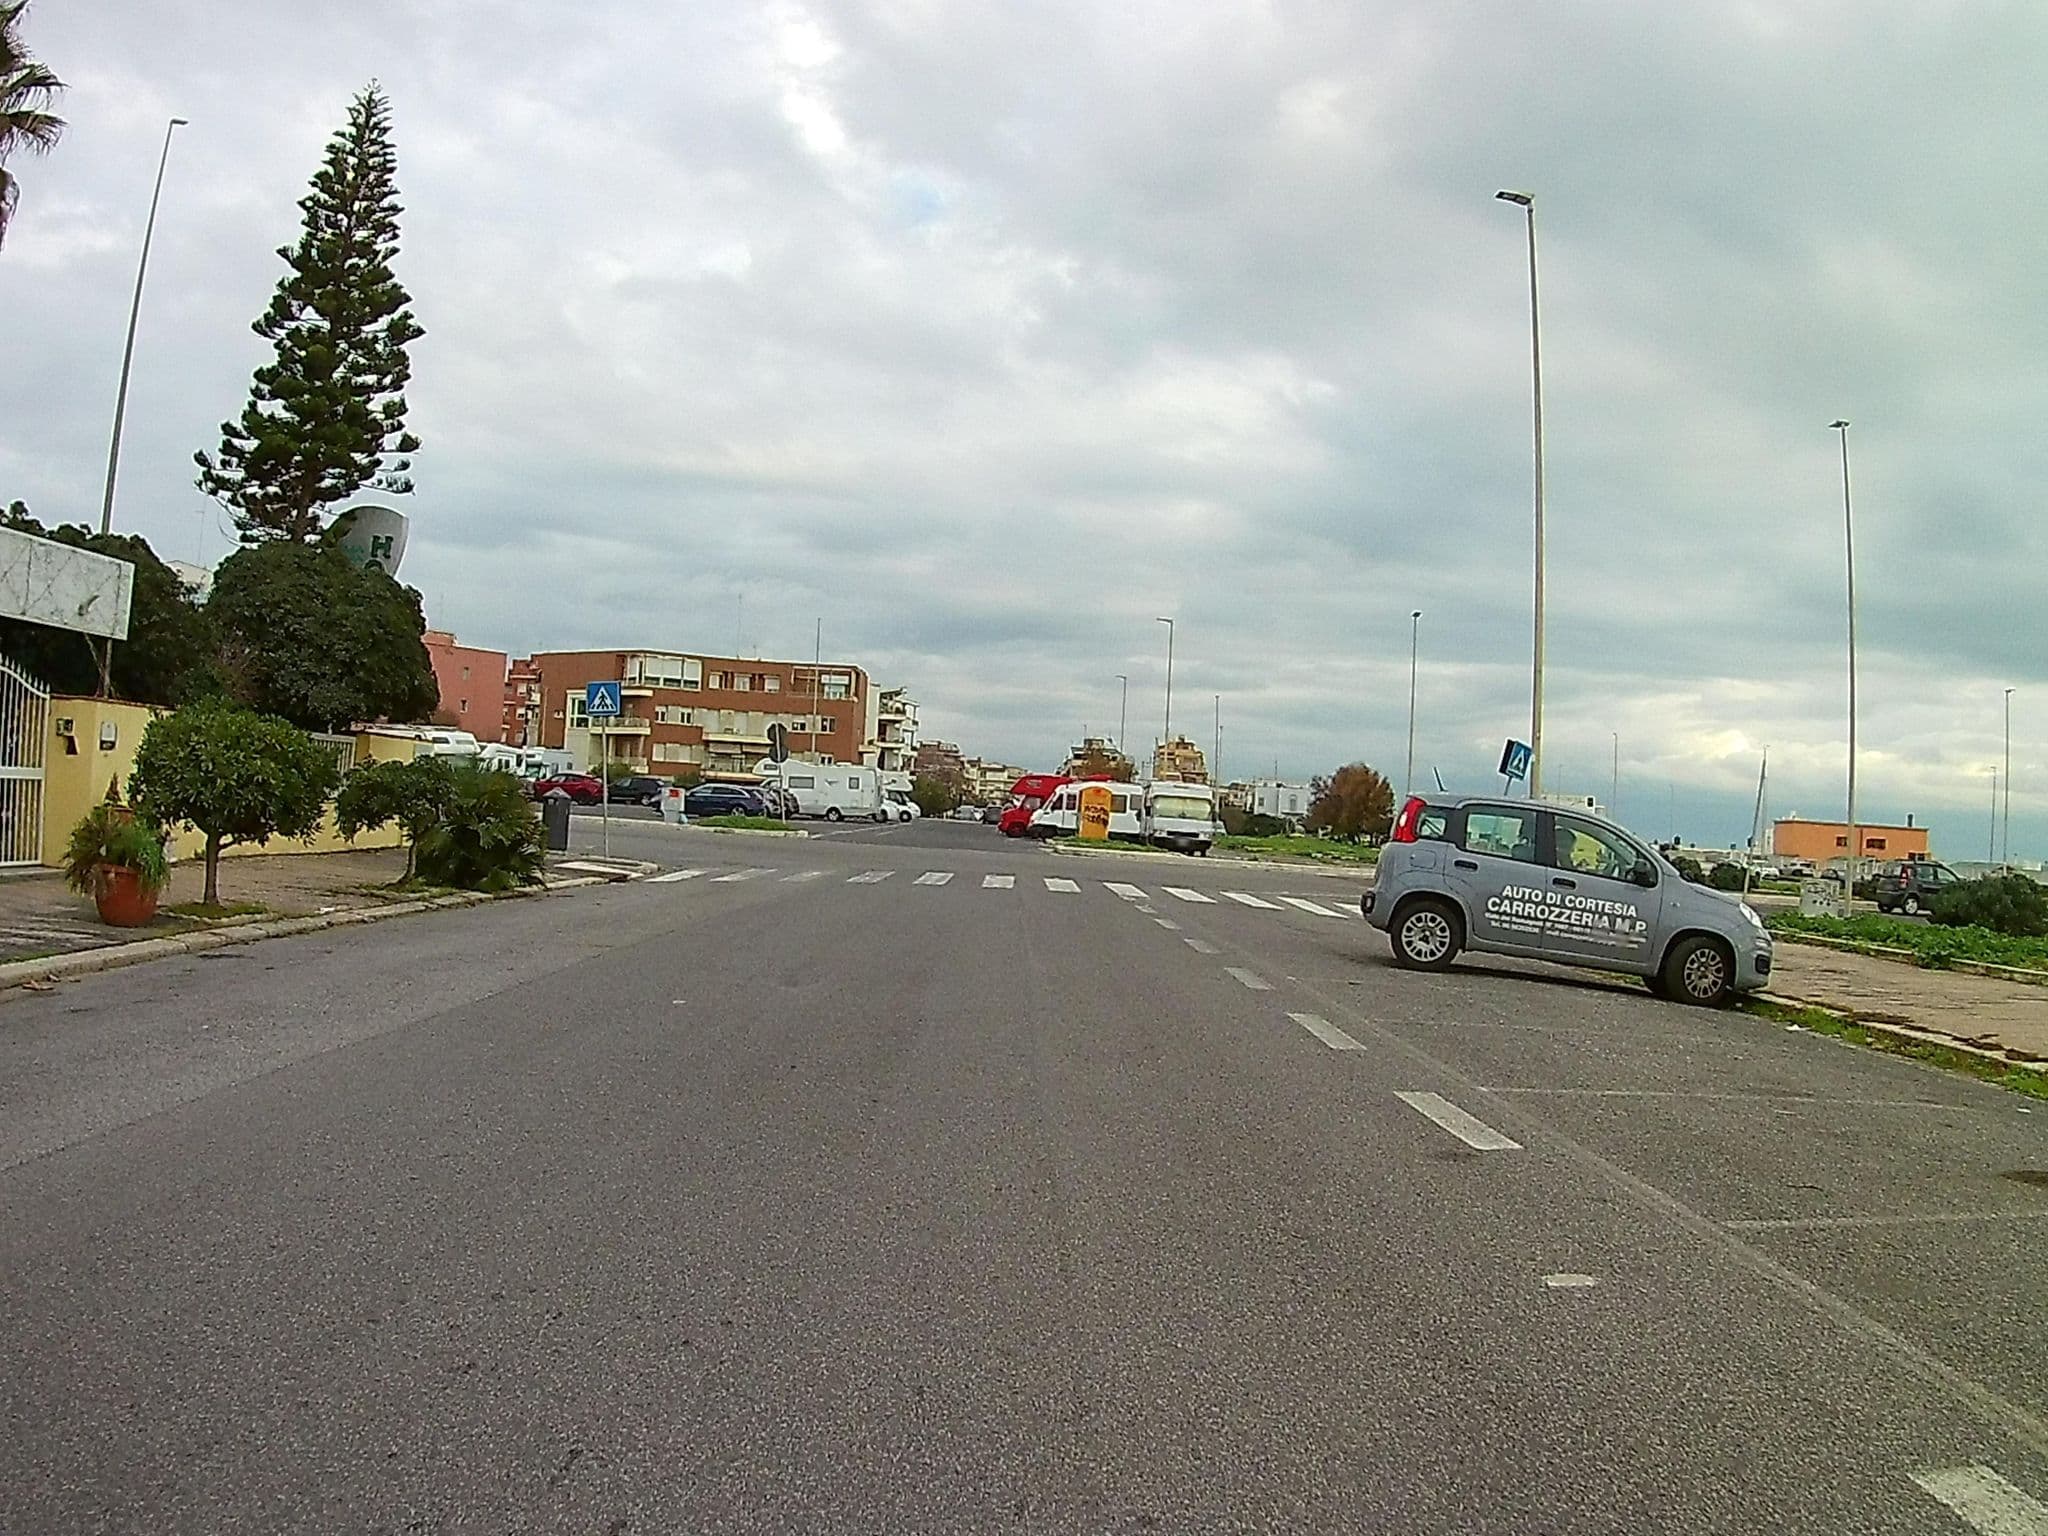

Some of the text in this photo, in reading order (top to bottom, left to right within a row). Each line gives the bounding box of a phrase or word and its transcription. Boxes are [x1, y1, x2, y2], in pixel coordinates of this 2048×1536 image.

[1487, 896, 1610, 929] CARROZZERIA
[1502, 885, 1637, 918] AUTO DI CORTESIA
